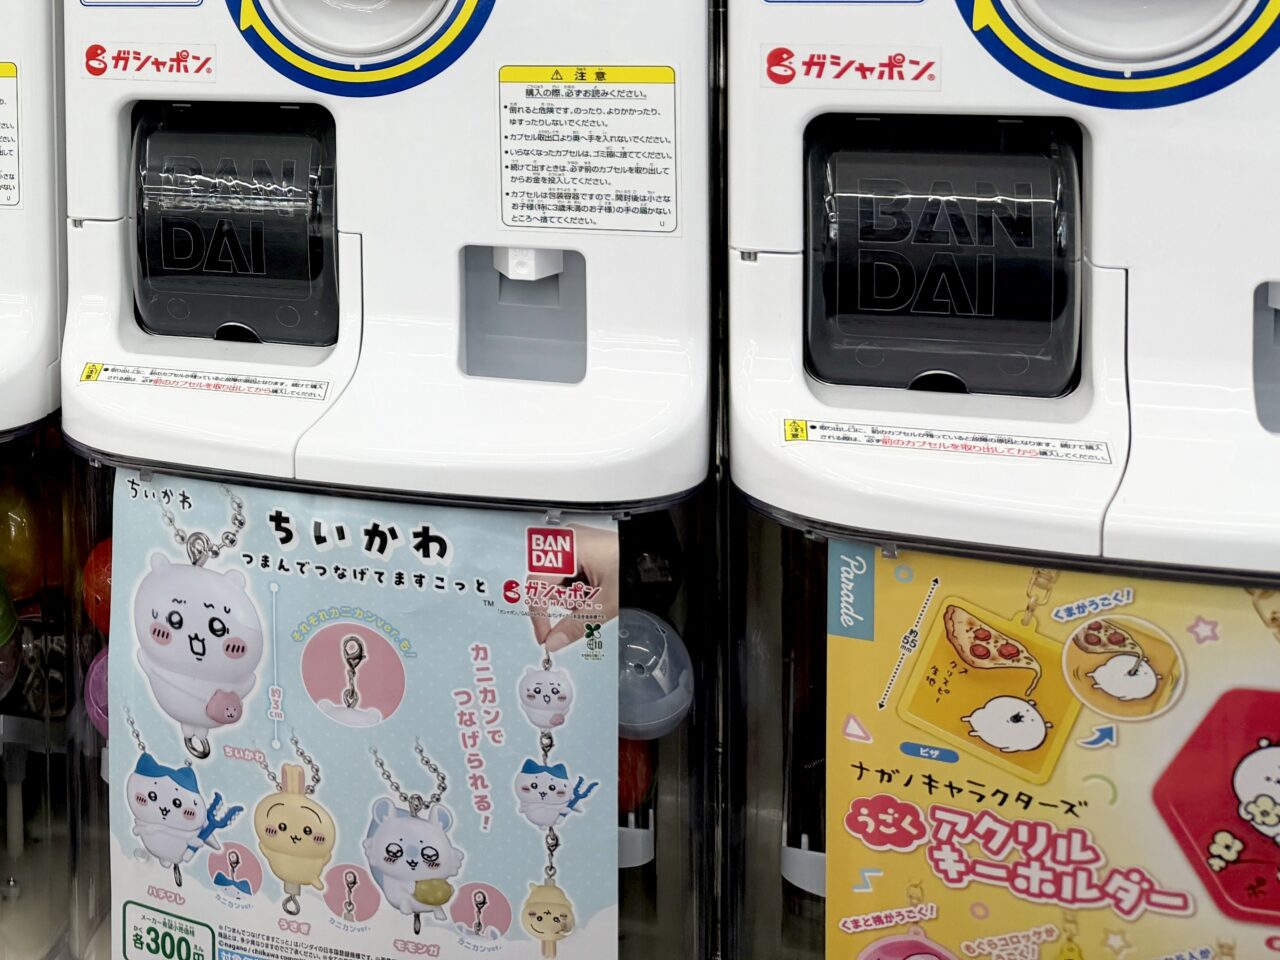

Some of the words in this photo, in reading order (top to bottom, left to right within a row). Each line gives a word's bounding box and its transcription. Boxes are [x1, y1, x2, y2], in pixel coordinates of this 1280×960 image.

[111, 47, 213, 74] ガシャポン
[801, 54, 935, 82] ガシャポン
[574, 71, 606, 81] 注意
[526, 89, 647, 98] 購入の際、必ずお読みください。
[509, 107, 660, 115] 倒れると危険です。のったり、よりかかったり、
[509, 119, 608, 127] ゆすったりしないでください。
[510, 134, 671, 143] カプセル取出口より奥へ手を入れないでください。
[510, 149, 672, 159] いらなくなったカプセルは、ゴミ箱に捨ててください。
[510, 164, 669, 174] 続けて出すときは、必ず前のカプセルを取り出して
[510, 176, 611, 185] からお金を投入してください。
[511, 191, 670, 202] カプセルは包装容器ですので、開封後は小さな
[512, 215, 597, 224] ところへ捨ててください。
[857, 178, 1035, 248] BAN
[161, 217, 266, 274] DAI
[857, 249, 995, 316] DAI
[127, 478, 192, 510] ちいかわ
[268, 510, 449, 561] ちいかわ
[531, 535, 570, 553] BAN
[531, 551, 563, 568] DAI
[241, 552, 486, 595] つまんでつなげてますこっと
[525, 582, 601, 600] ガシャポン
[839, 554, 867, 628] Parade
[1052, 589, 1133, 621] くまがうごく!
[471, 644, 504, 744] カニカンで
[224, 745, 265, 765] ちいかわ
[454, 690, 491, 830] つなげられる!
[850, 761, 1089, 818] ナガノキャラクターズ
[856, 808, 918, 835] うごく
[931, 808, 1100, 864] アクリル
[931, 844, 1190, 914] キーホルダー
[148, 887, 185, 905] ハチワレ
[278, 918, 312, 935] うさぎ
[394, 940, 440, 956] モモンガ
